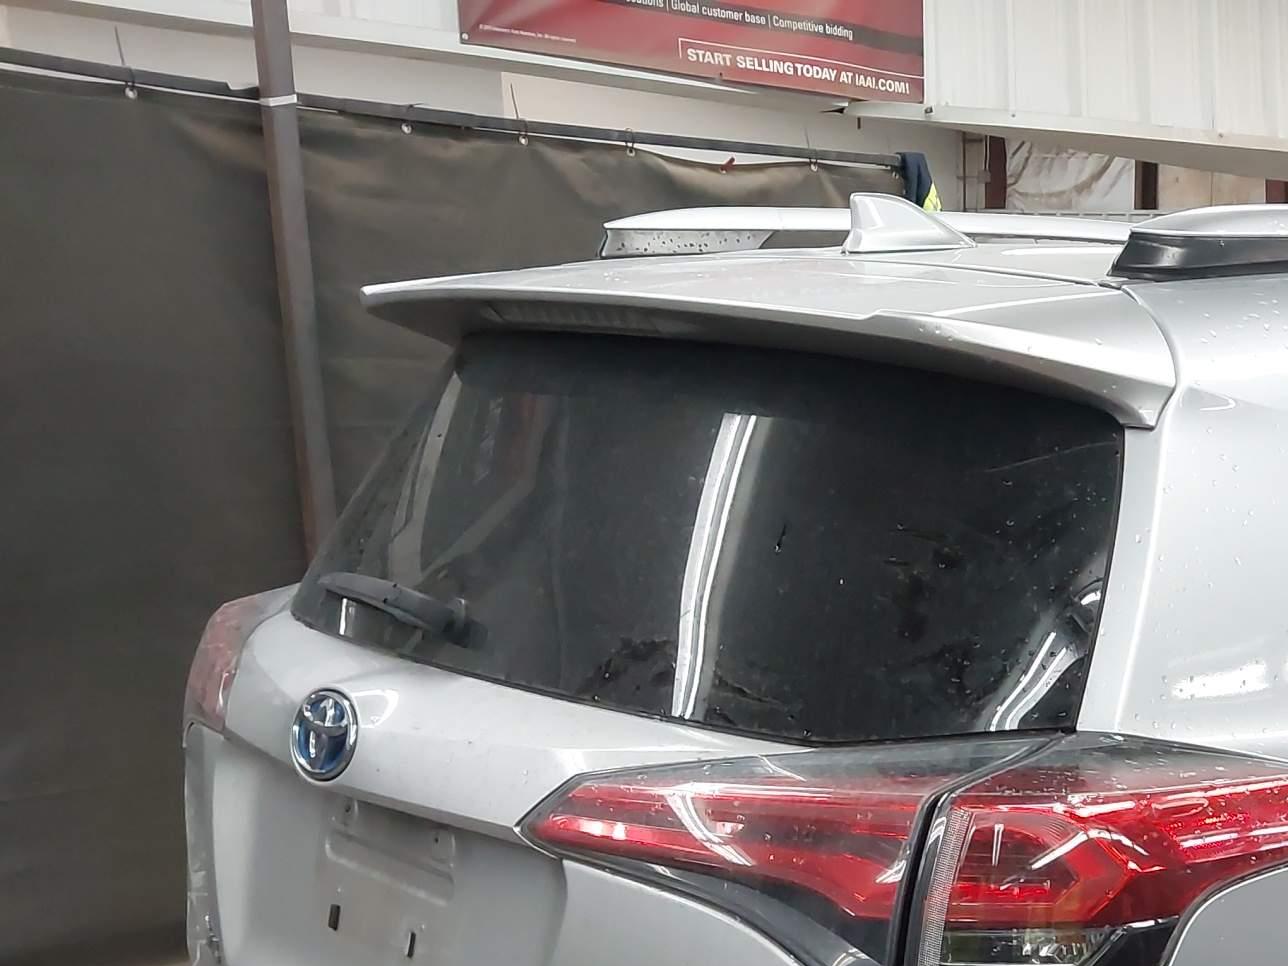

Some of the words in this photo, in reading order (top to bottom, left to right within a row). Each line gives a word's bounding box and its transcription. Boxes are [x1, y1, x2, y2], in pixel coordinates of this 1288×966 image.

[671, 0, 700, 14] Global
[701, 6, 743, 21] customer
[744, 12, 766, 25] base
[772, 15, 824, 34] Competitive
[825, 23, 853, 41] bidding
[687, 48, 732, 67] START
[736, 55, 794, 76] SELLING
[795, 62, 838, 82] TODAY
[839, 71, 854, 85] AT
[855, 73, 910, 95] IAAI.COM!
